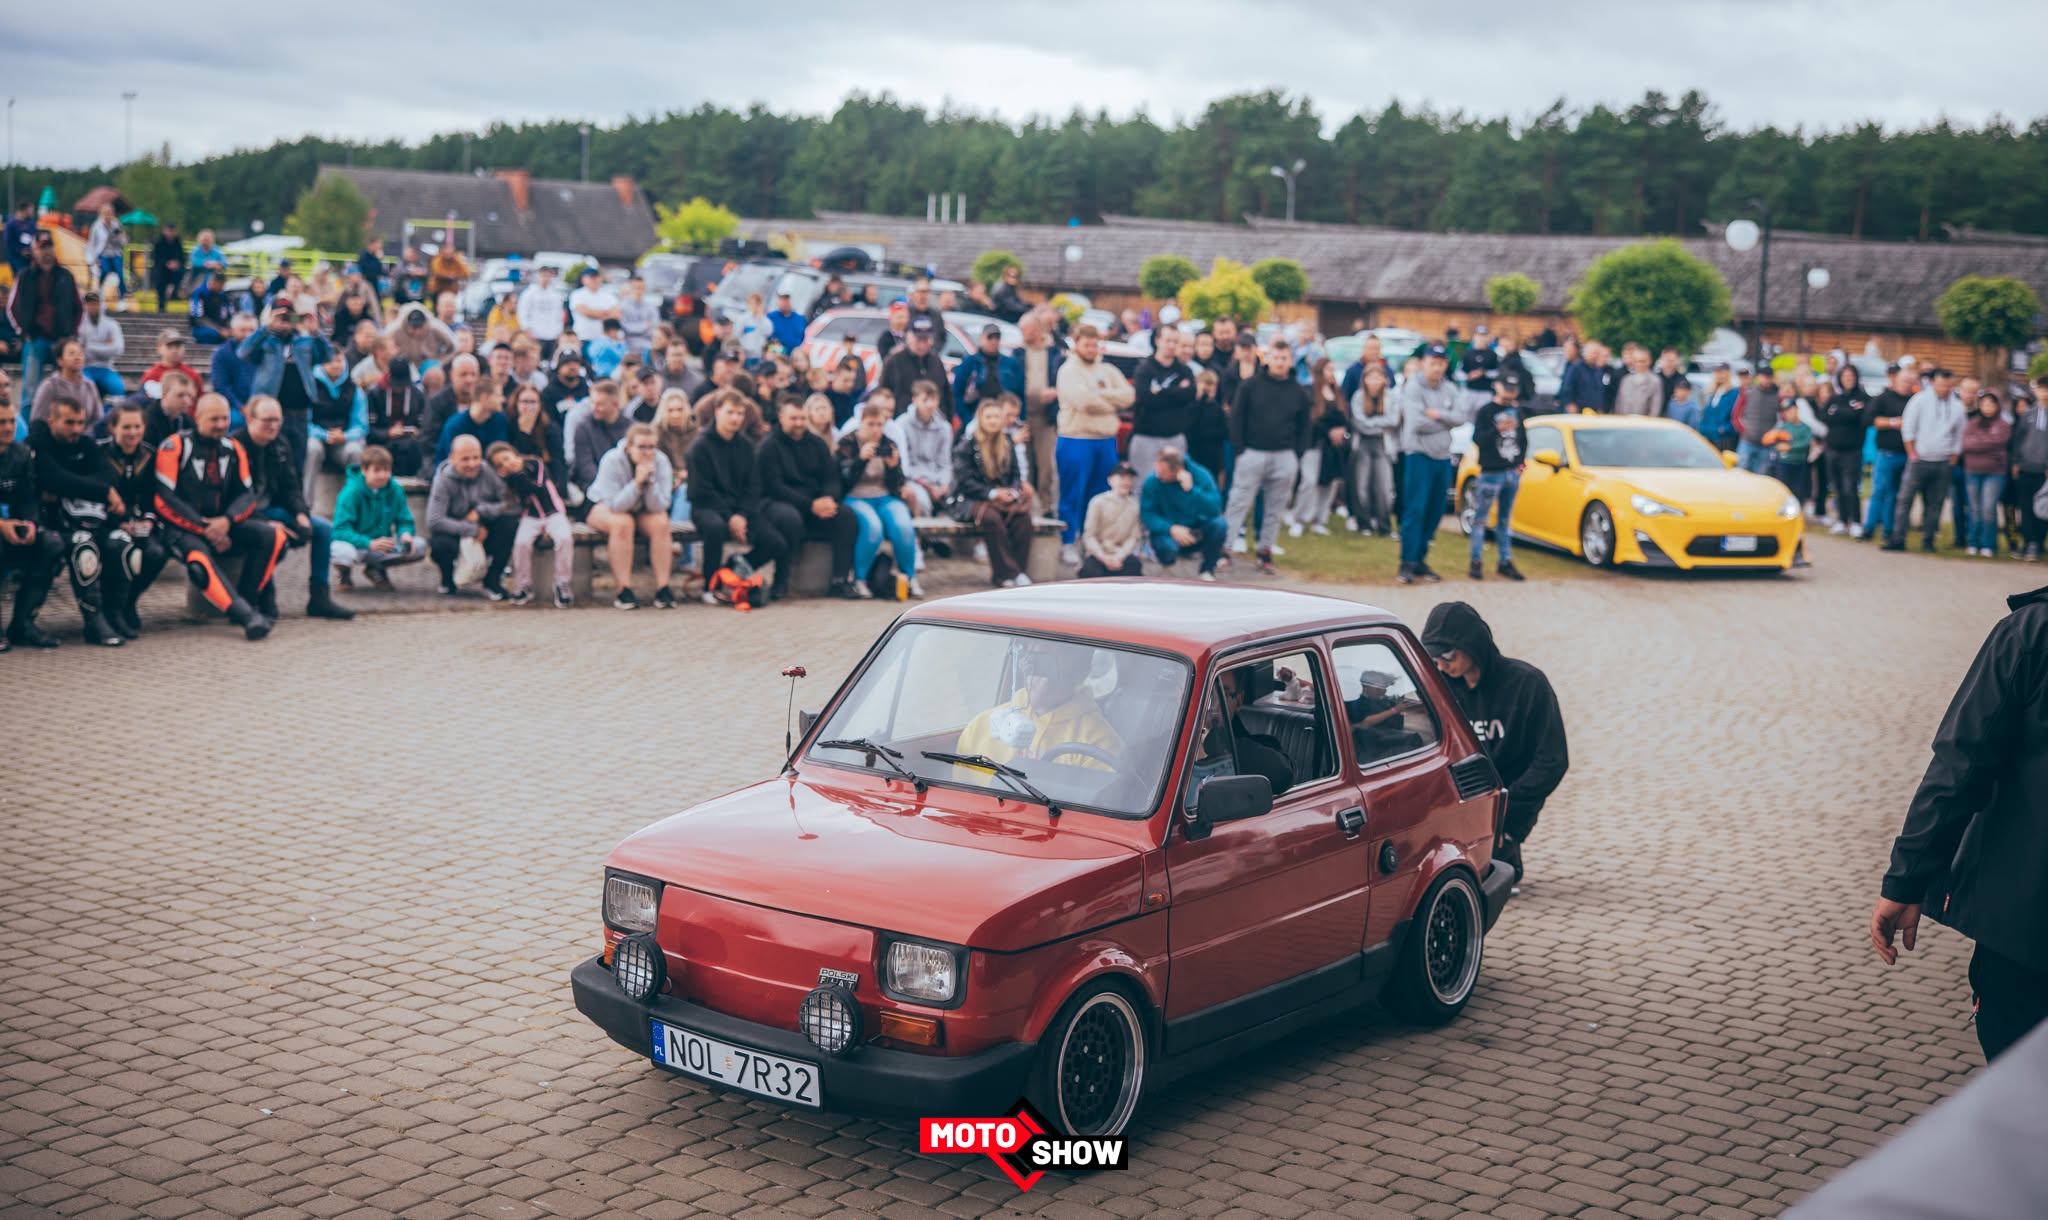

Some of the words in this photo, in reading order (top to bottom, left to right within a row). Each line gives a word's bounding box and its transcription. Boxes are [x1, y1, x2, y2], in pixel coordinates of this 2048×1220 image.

[821, 969, 857, 981] POLSKI
[654, 1045, 665, 1057] PL
[670, 1031, 723, 1078] NOL
[734, 1051, 813, 1102] 7R32
